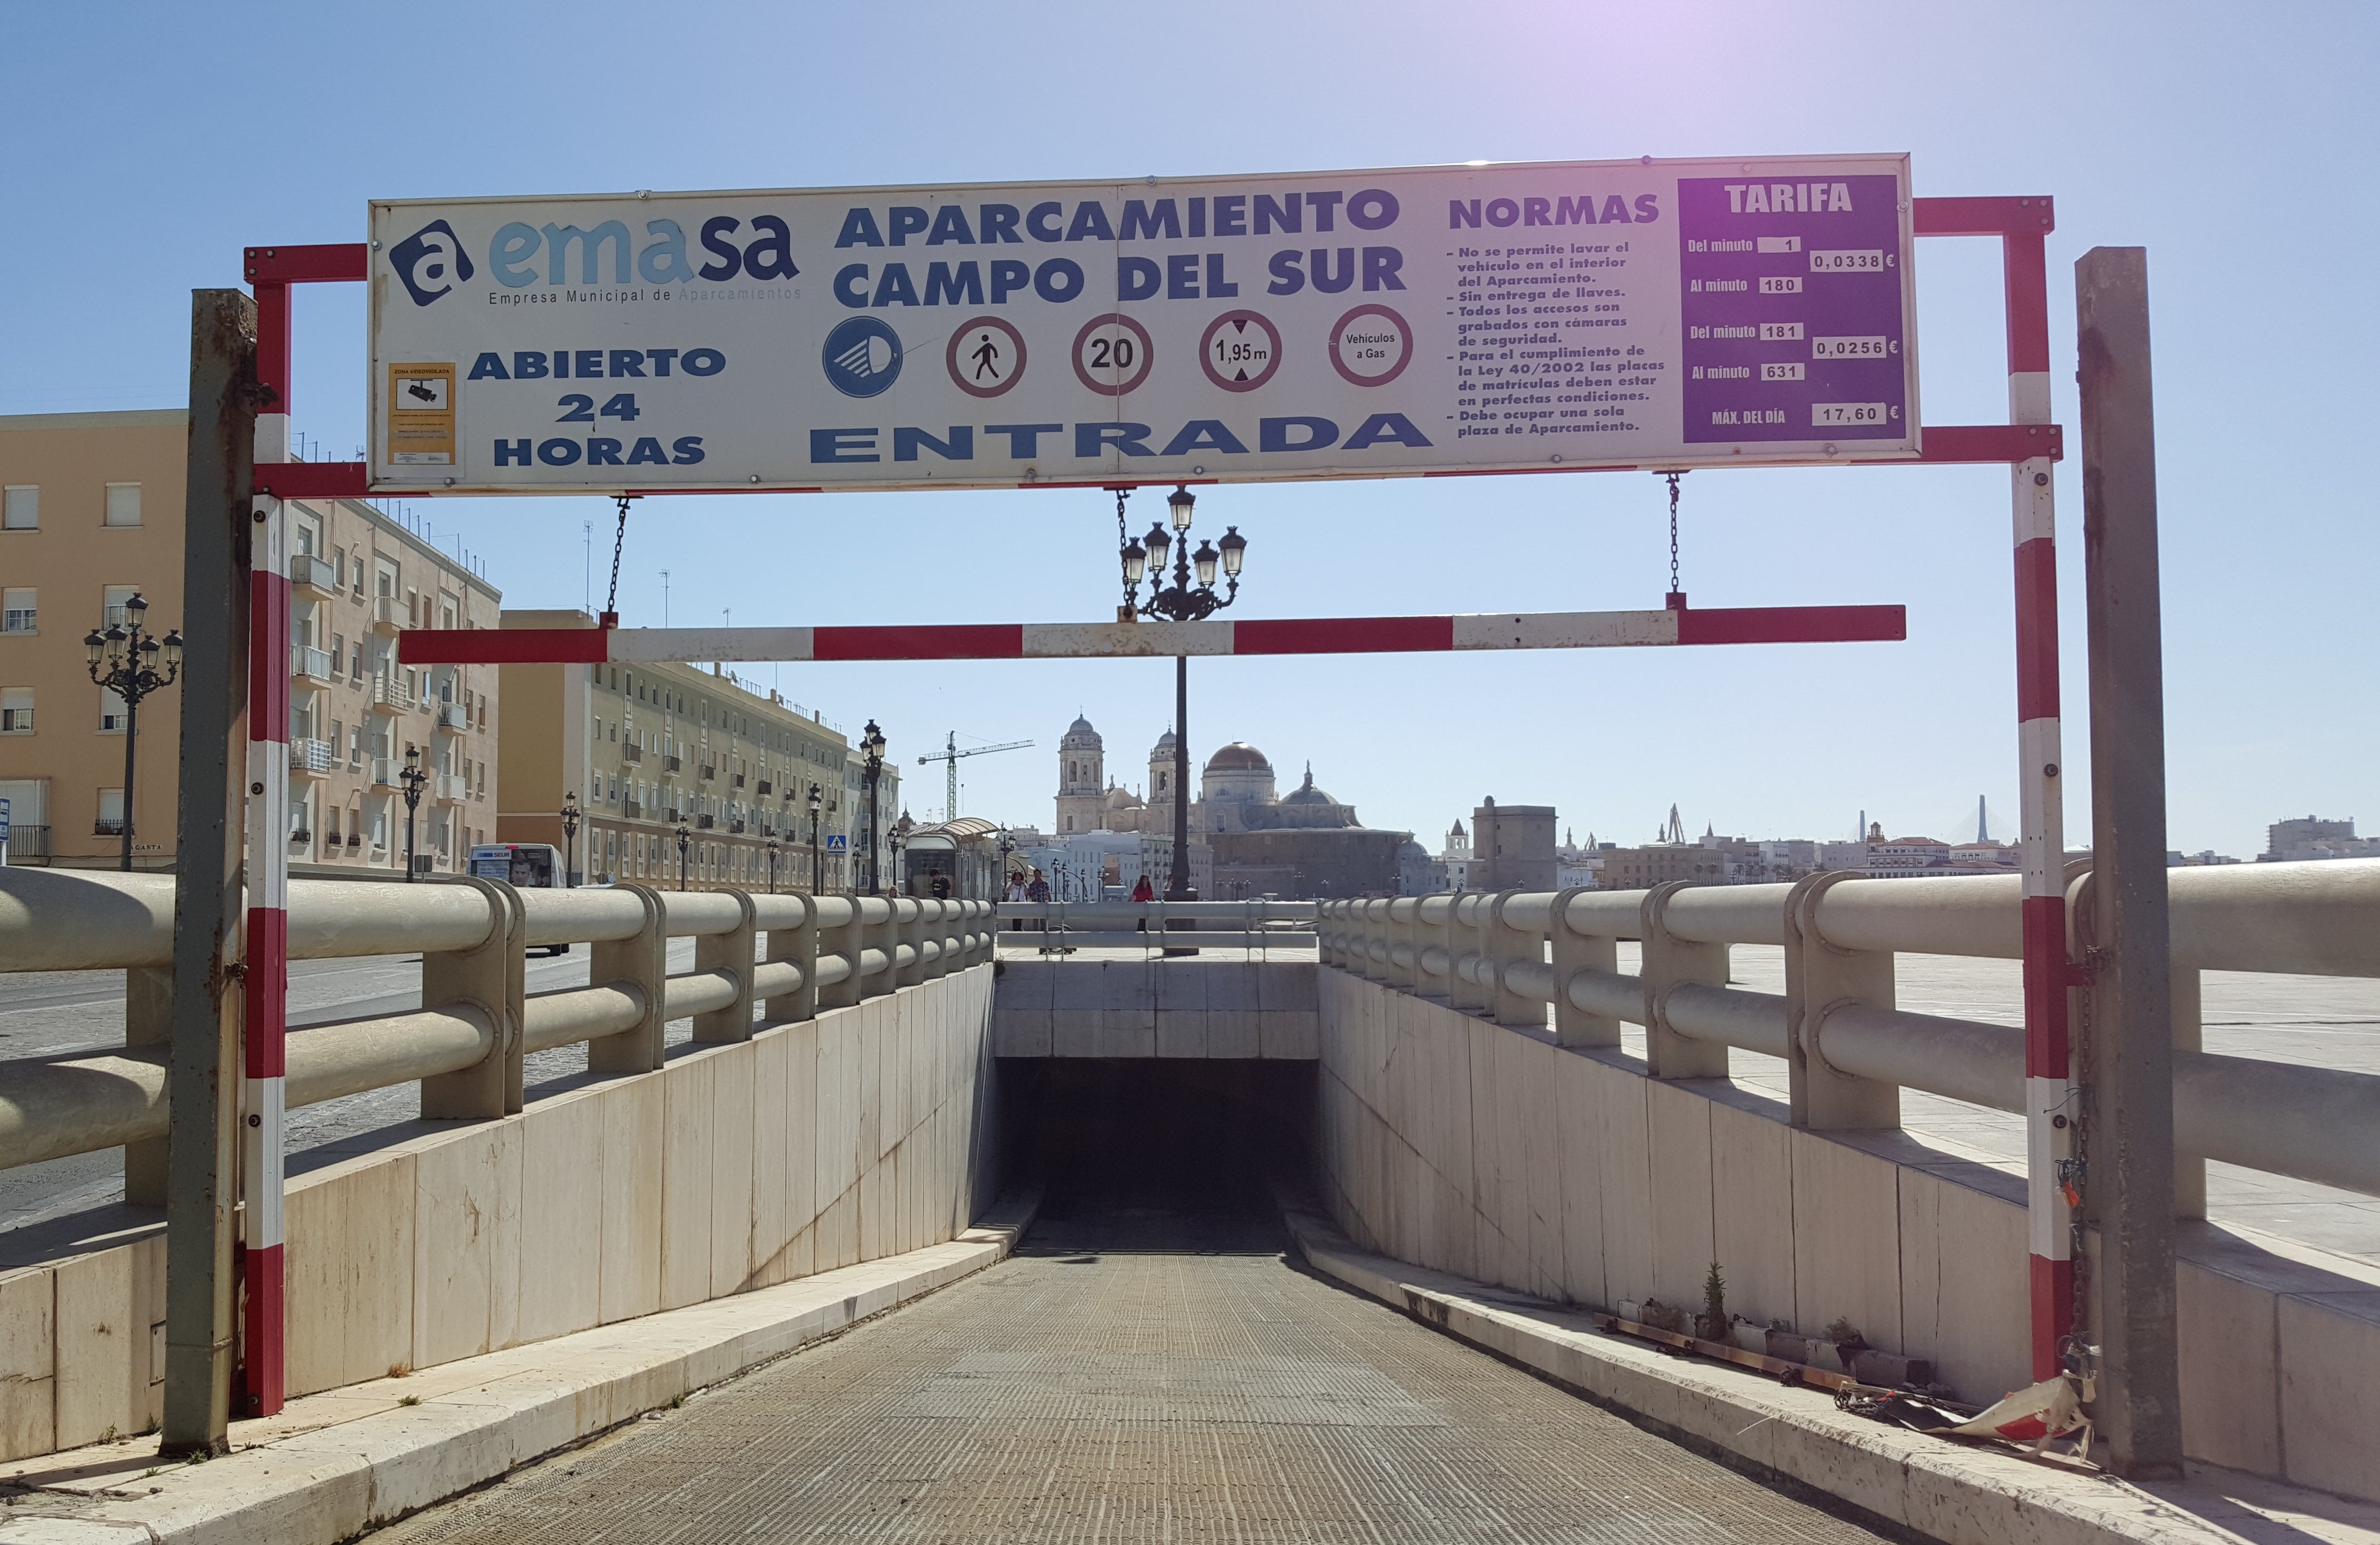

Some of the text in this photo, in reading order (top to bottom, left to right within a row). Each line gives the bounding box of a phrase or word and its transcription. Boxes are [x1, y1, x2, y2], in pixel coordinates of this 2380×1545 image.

[1724, 183, 1852, 213] TARIFA
[834, 189, 1400, 248] APARCAMIENTO
[1449, 194, 1659, 229] NORMAS
[489, 215, 800, 288] emasa
[1459, 242, 1628, 258] No se permite lavar el
[1688, 238, 1792, 252] Del minuto 1
[1458, 257, 1626, 271] vehículo en el interior
[1815, 254, 1894, 269] 0,0338 €
[833, 246, 1408, 308] CAMPO DEL SUR
[1458, 273, 1596, 288] del Aparcamiento.
[1691, 279, 1794, 292] Al minuto 180
[490, 287, 801, 307] Empresa Municipal de Aparcamientos
[1459, 287, 1625, 302] Sin entrega de llaves.
[1459, 304, 1620, 317] Todos los accesos son
[1458, 318, 1627, 334] grabados con cámaras
[1691, 325, 1796, 339] Del minuto 181
[1346, 333, 1395, 346] Vehículos
[1458, 333, 1562, 348] de seguridad.
[1091, 338, 1133, 368] 20
[1365, 348, 1386, 359] Gas
[1460, 346, 1644, 361] Para el cumplimiento de
[1817, 340, 1897, 356] 0,0256 €
[467, 348, 726, 379] ABIERTO
[1458, 360, 1664, 377] la Ley 40/2002 las placas
[1692, 366, 1796, 379] Al minuto 631
[1458, 376, 1656, 391] de matrículas deben estar
[1458, 391, 1649, 407] en perfectas condiciones.
[555, 394, 640, 422] 24
[1460, 406, 1624, 421] Debe ocupar una sola
[1823, 406, 1898, 423] 17,60 €
[1712, 408, 1785, 425] MÁX. DEL DÍA
[810, 413, 1435, 463] ENTRADA
[1458, 422, 1639, 438] plaza de Aparcamiento.
[494, 436, 705, 466] HORAS
